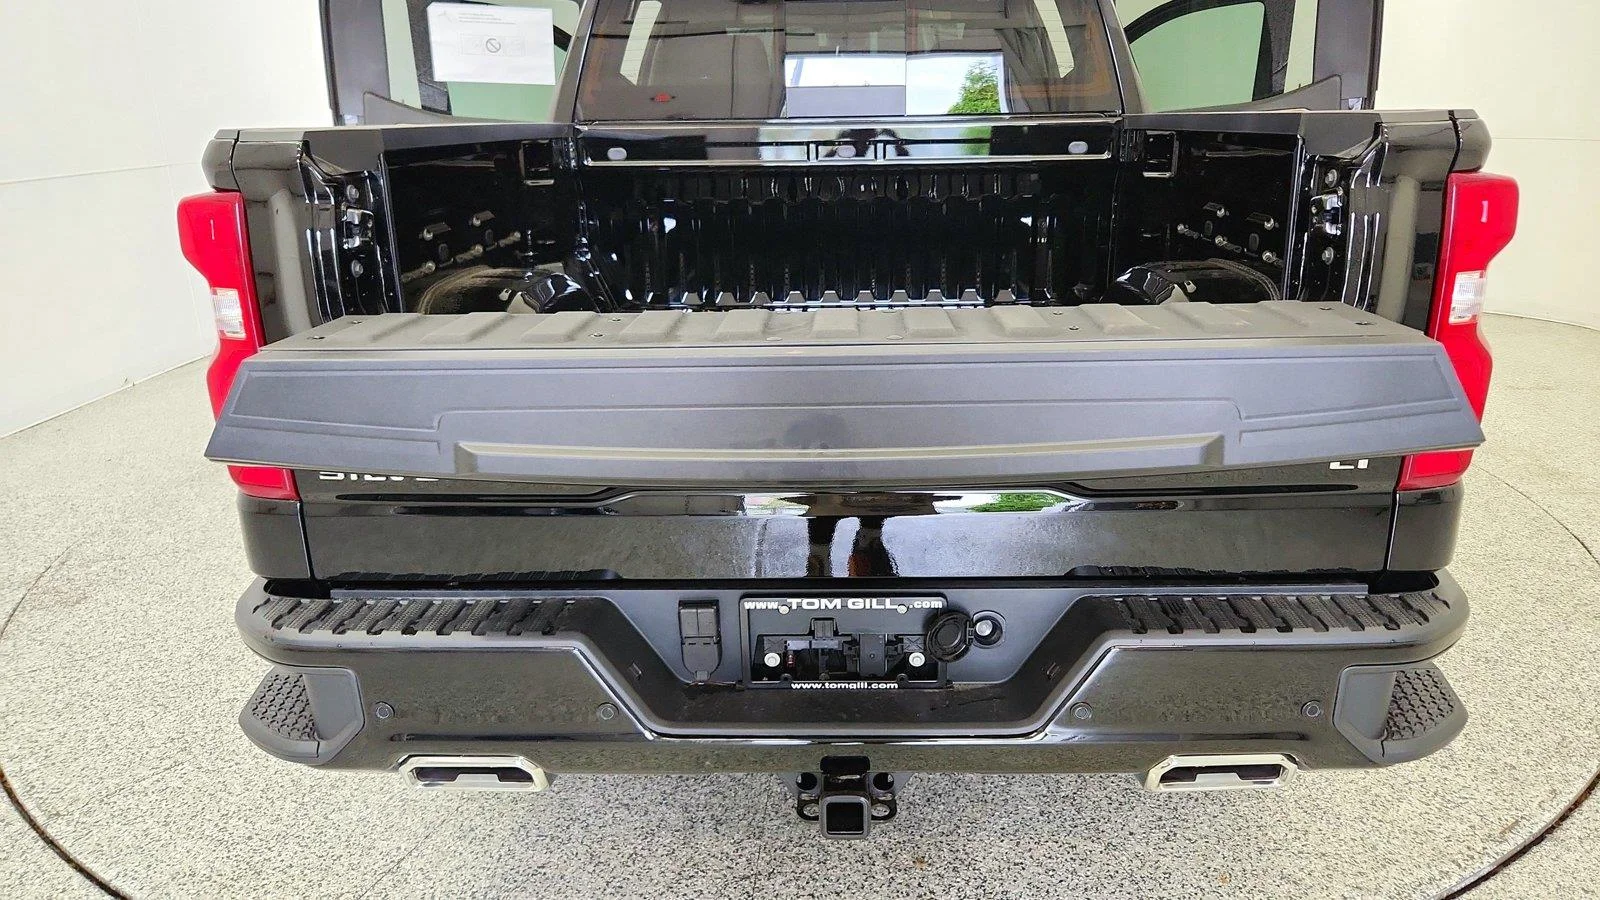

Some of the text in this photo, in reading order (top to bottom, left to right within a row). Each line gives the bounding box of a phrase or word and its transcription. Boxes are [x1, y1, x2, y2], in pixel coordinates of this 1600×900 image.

[786, 598, 842, 610] TOM
[847, 598, 899, 610] GILL
[909, 600, 943, 609] .com
[790, 681, 899, 690] www.tomgill.com
